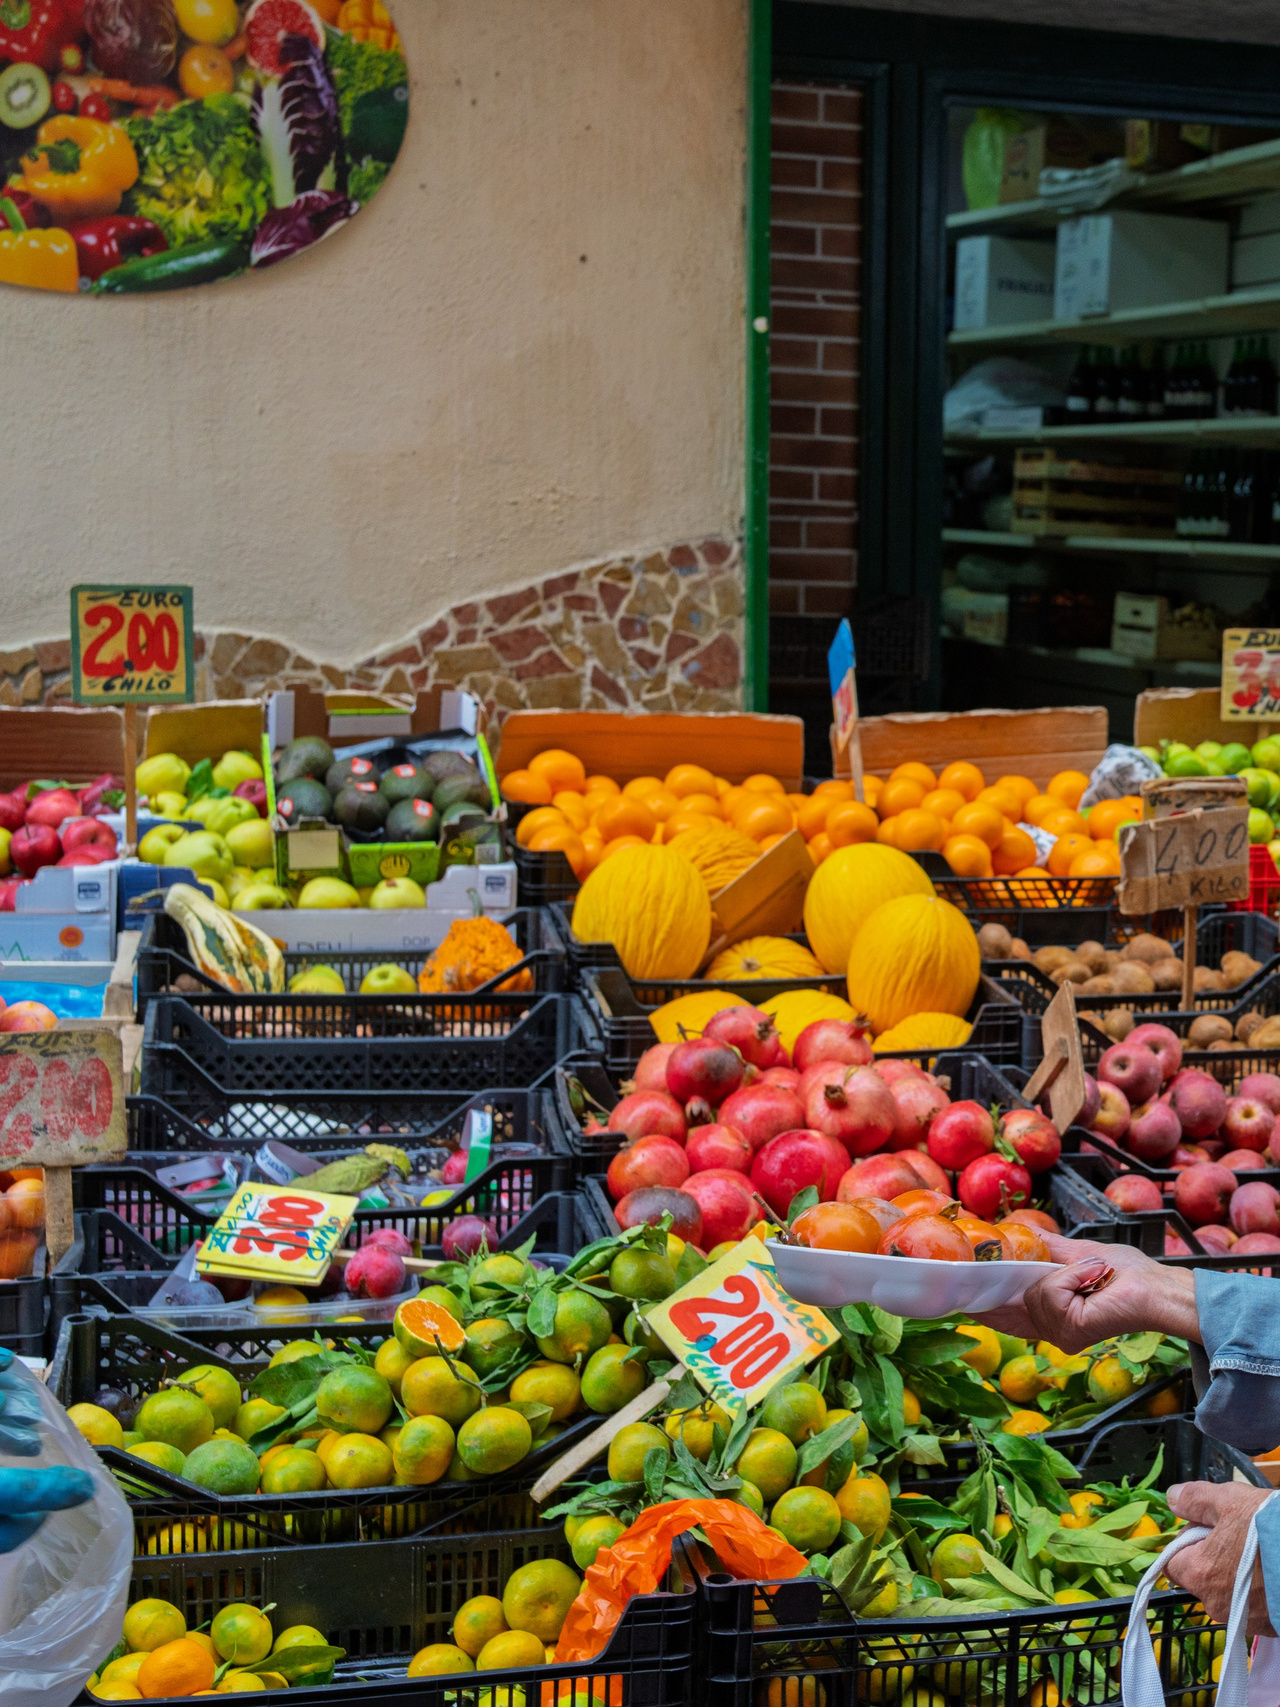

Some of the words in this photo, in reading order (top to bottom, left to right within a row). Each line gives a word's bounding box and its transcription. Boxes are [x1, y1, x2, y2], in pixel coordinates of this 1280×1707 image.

[119, 589, 183, 608] EURO
[102, 674, 171, 692] CHILO
[1189, 876, 1243, 897] KILO
